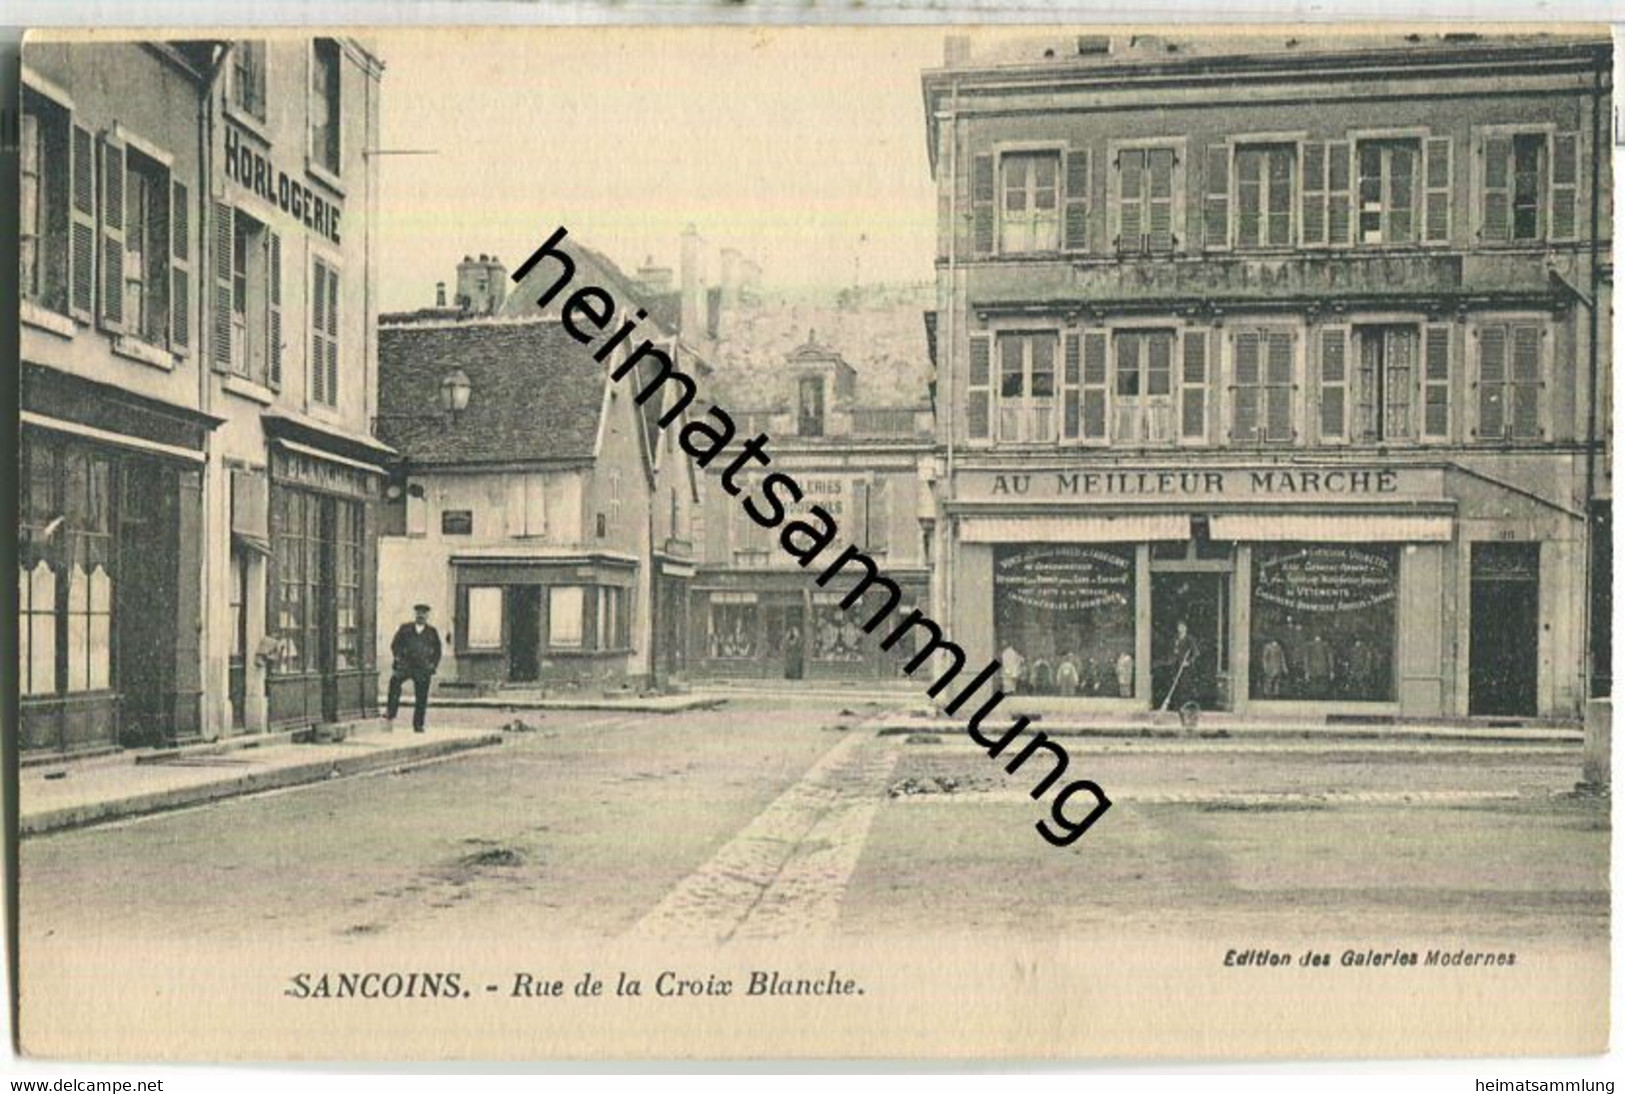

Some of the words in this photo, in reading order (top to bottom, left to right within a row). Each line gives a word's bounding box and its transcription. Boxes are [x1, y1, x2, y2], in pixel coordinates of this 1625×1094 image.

[224, 125, 341, 245] HORLOGERIE
[992, 474, 1030, 494] AU
[1057, 472, 1224, 494] MEILLEUR
[1251, 469, 1400, 493] MARCHÉ
